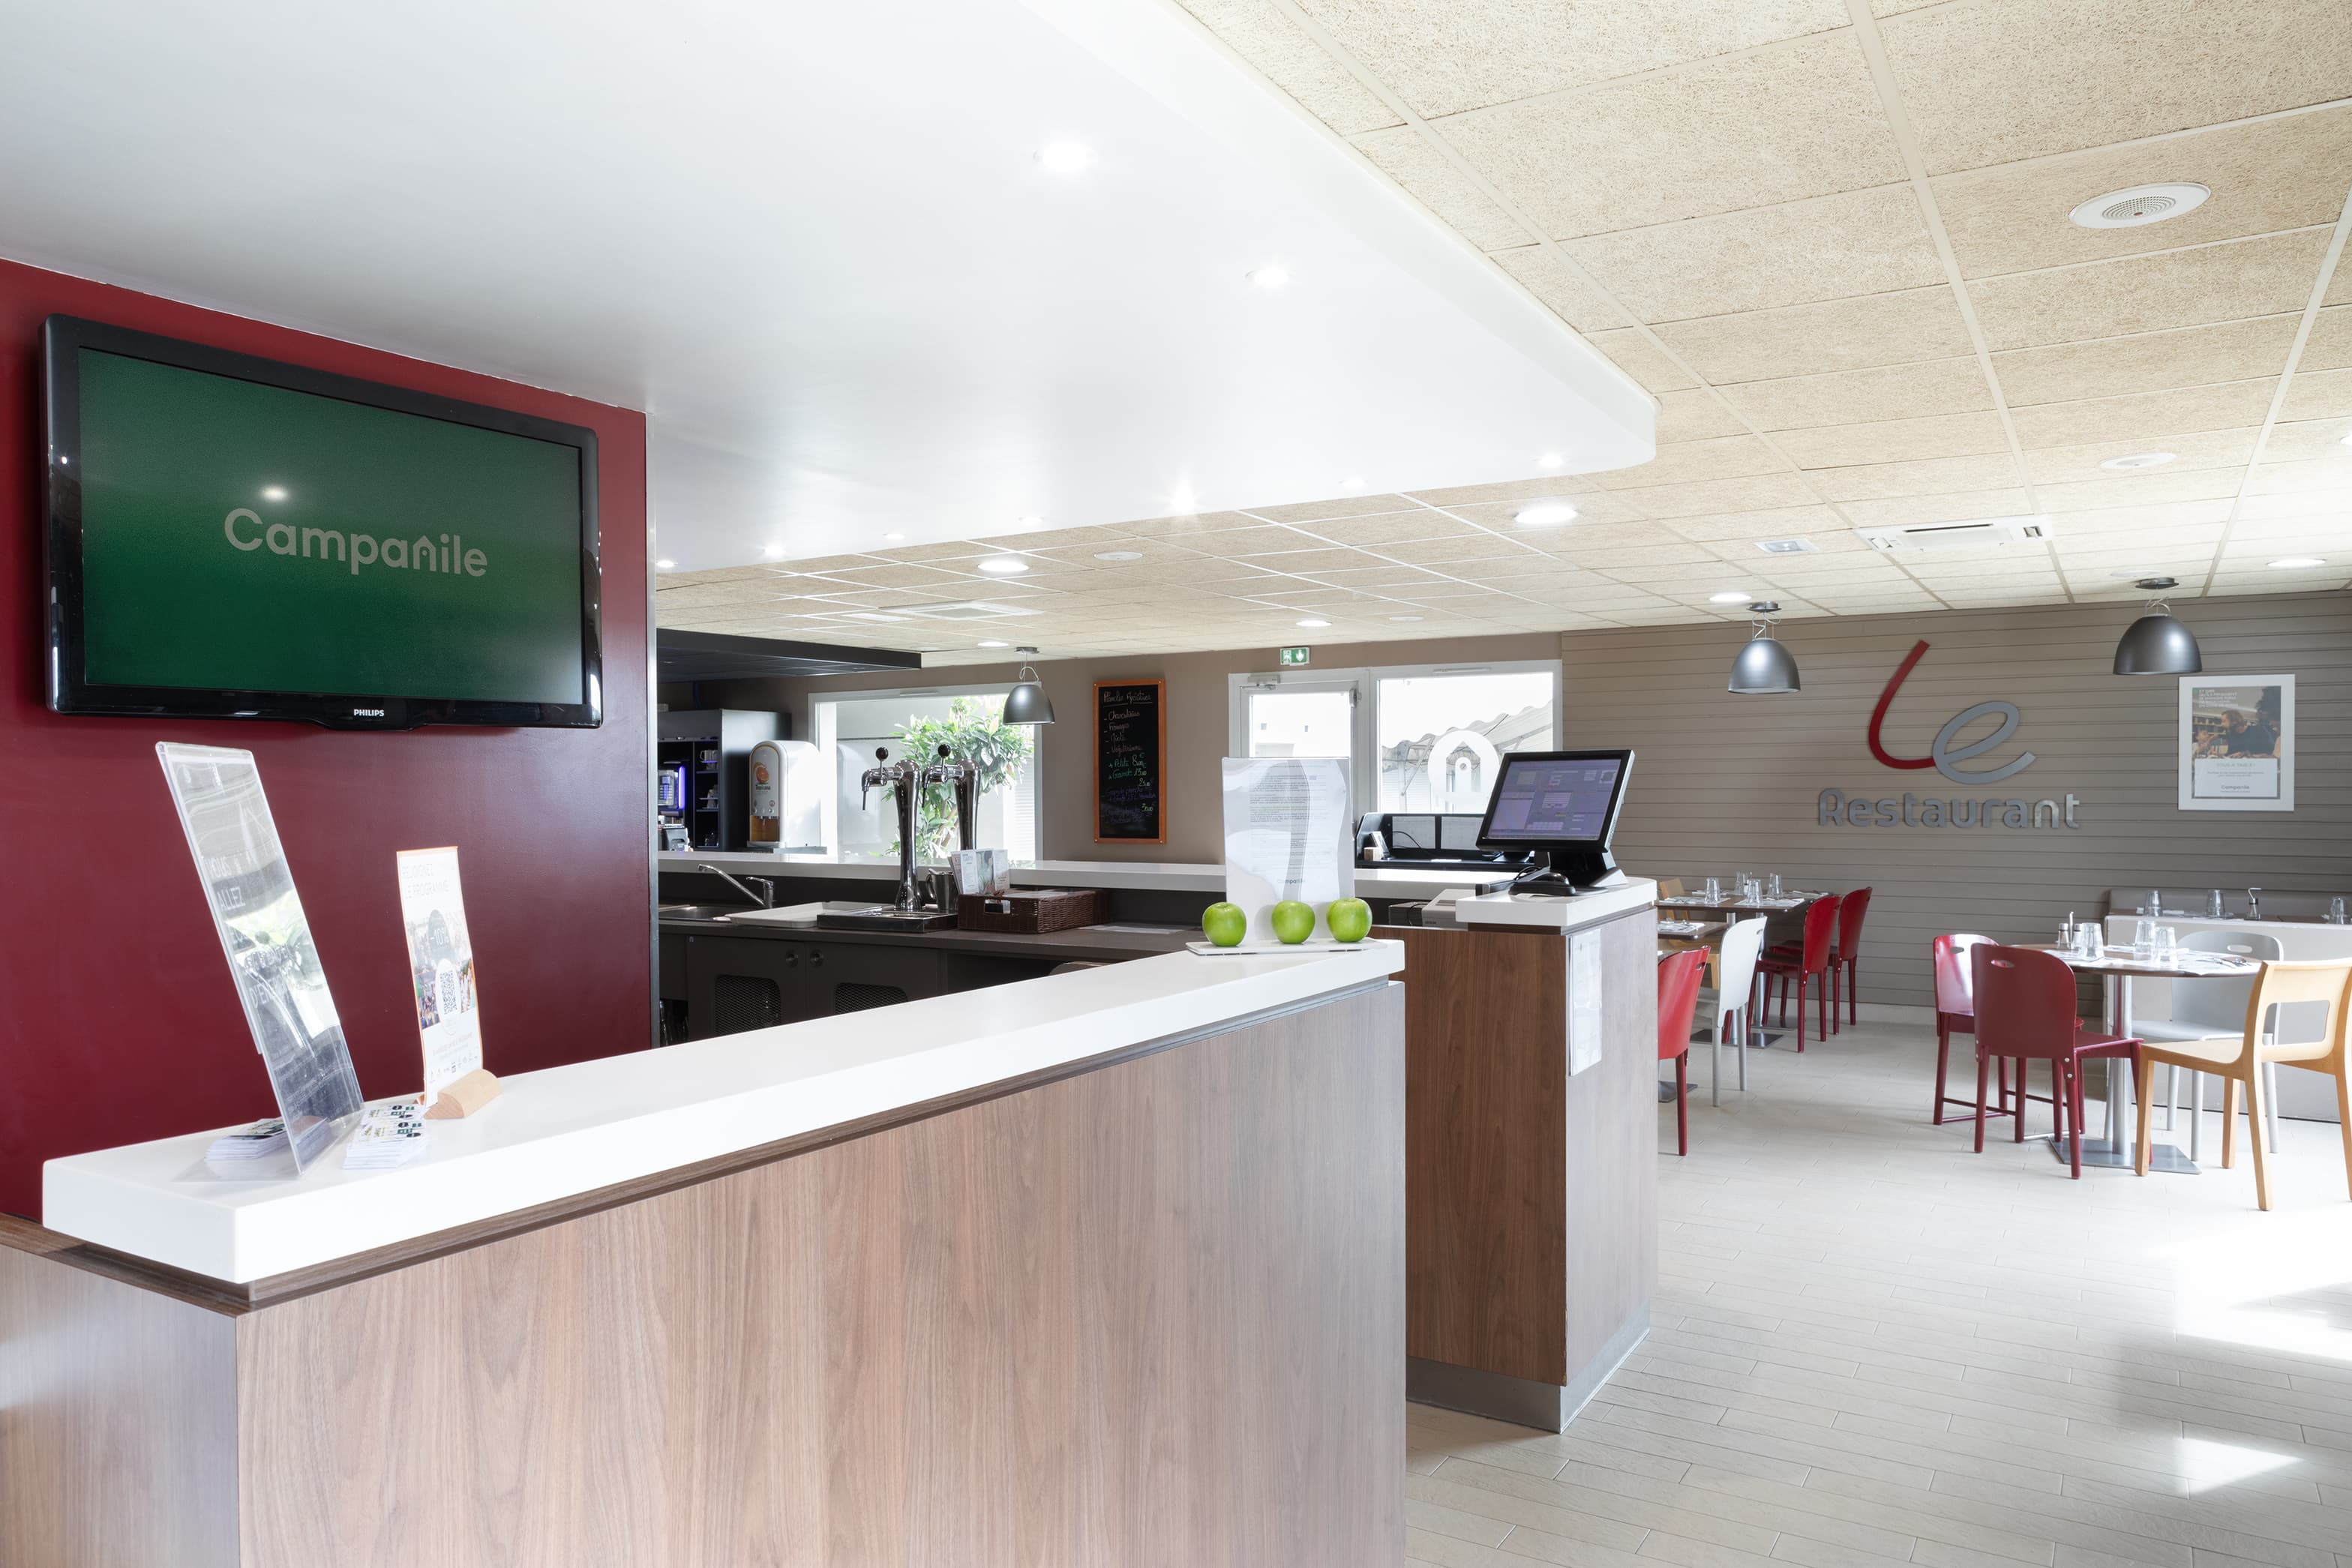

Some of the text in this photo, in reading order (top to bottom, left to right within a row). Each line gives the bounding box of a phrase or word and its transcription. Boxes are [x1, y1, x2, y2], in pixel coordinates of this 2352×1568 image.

[225, 508, 488, 577] Campanile
[353, 709, 385, 717] PHILIPS
[1868, 639, 2036, 785] Le
[1817, 787, 2081, 829] Restaurant
[217, 886, 246, 912] ALLEZ
